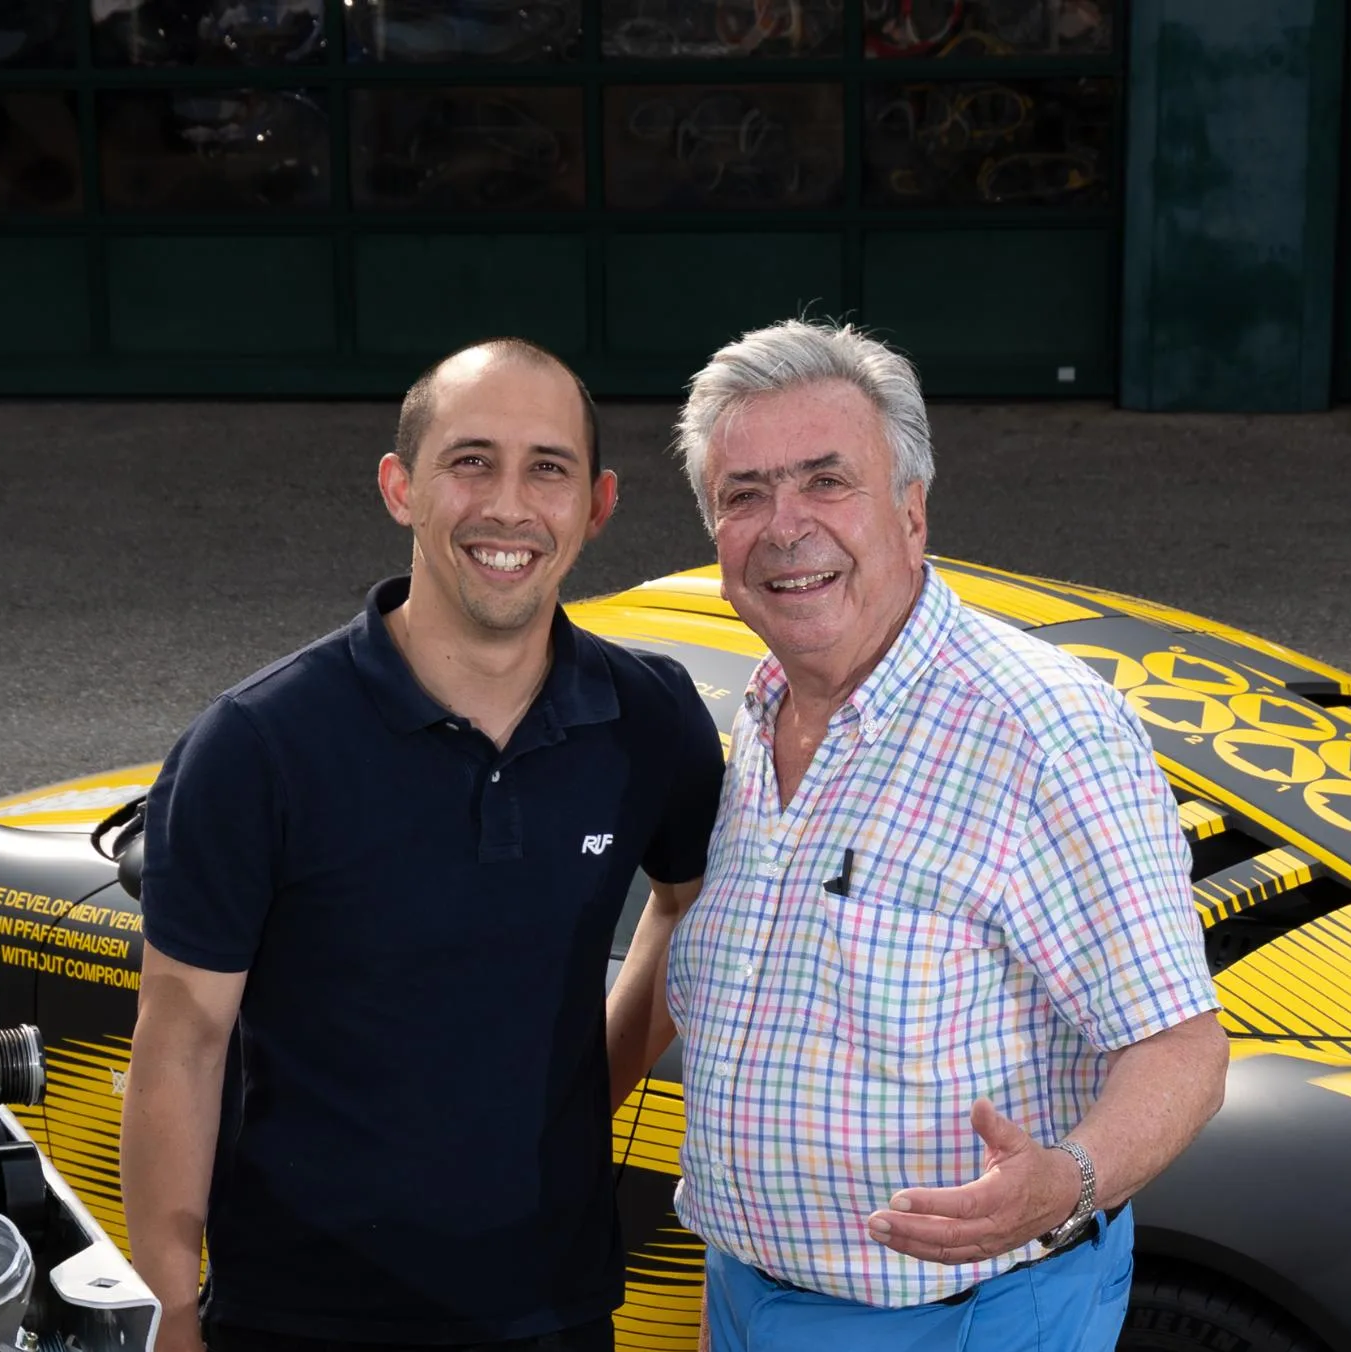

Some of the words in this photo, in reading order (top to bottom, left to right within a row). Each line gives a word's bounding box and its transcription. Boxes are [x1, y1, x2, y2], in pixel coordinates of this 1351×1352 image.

[4, 889, 112, 926] DEVELOPMENT
[14, 919, 130, 960] PFAFFENHAUSEN
[0, 943, 65, 975] WITHOUT
